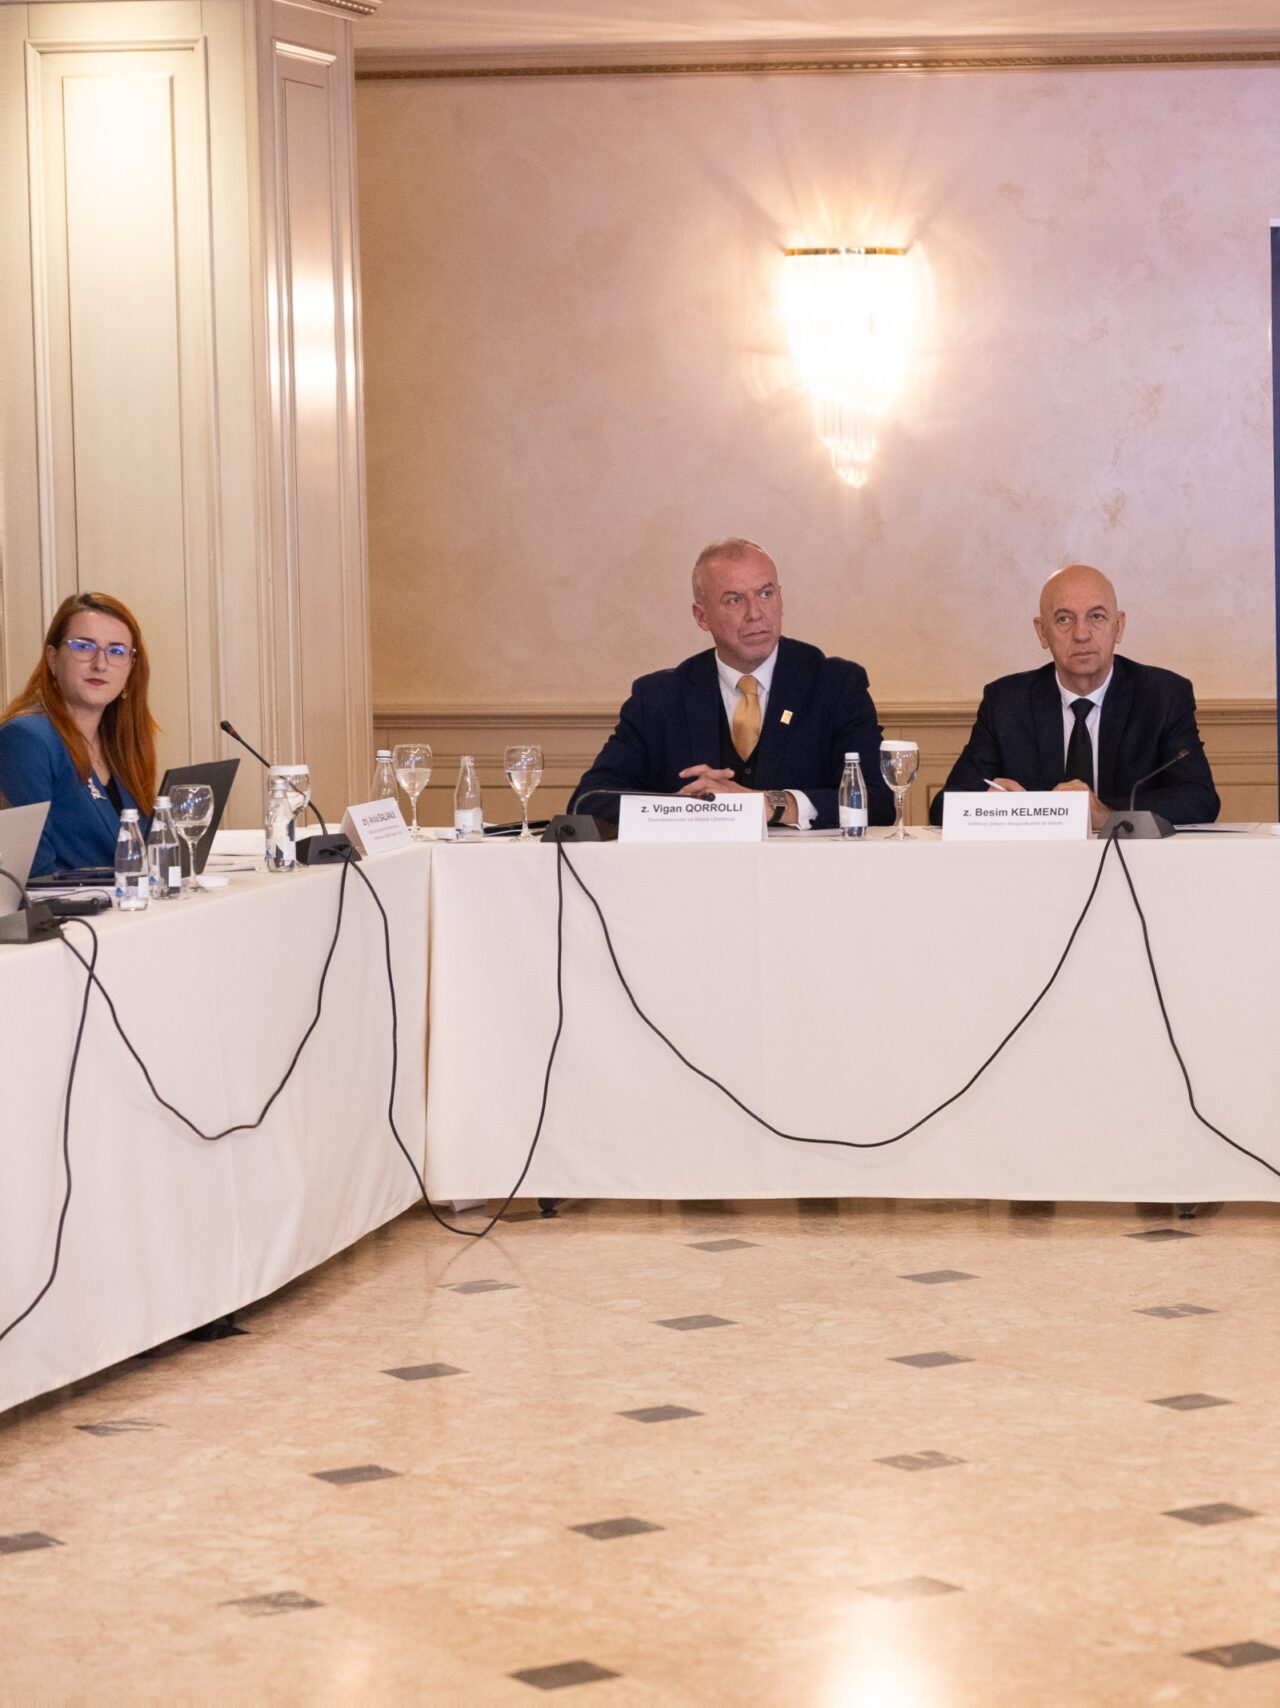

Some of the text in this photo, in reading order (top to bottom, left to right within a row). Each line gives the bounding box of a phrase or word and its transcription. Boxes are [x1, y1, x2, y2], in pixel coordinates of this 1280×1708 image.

[641, 803, 743, 815] z. Vigan QORROLLI
[963, 807, 1069, 817] z. Besim KELMENDI
